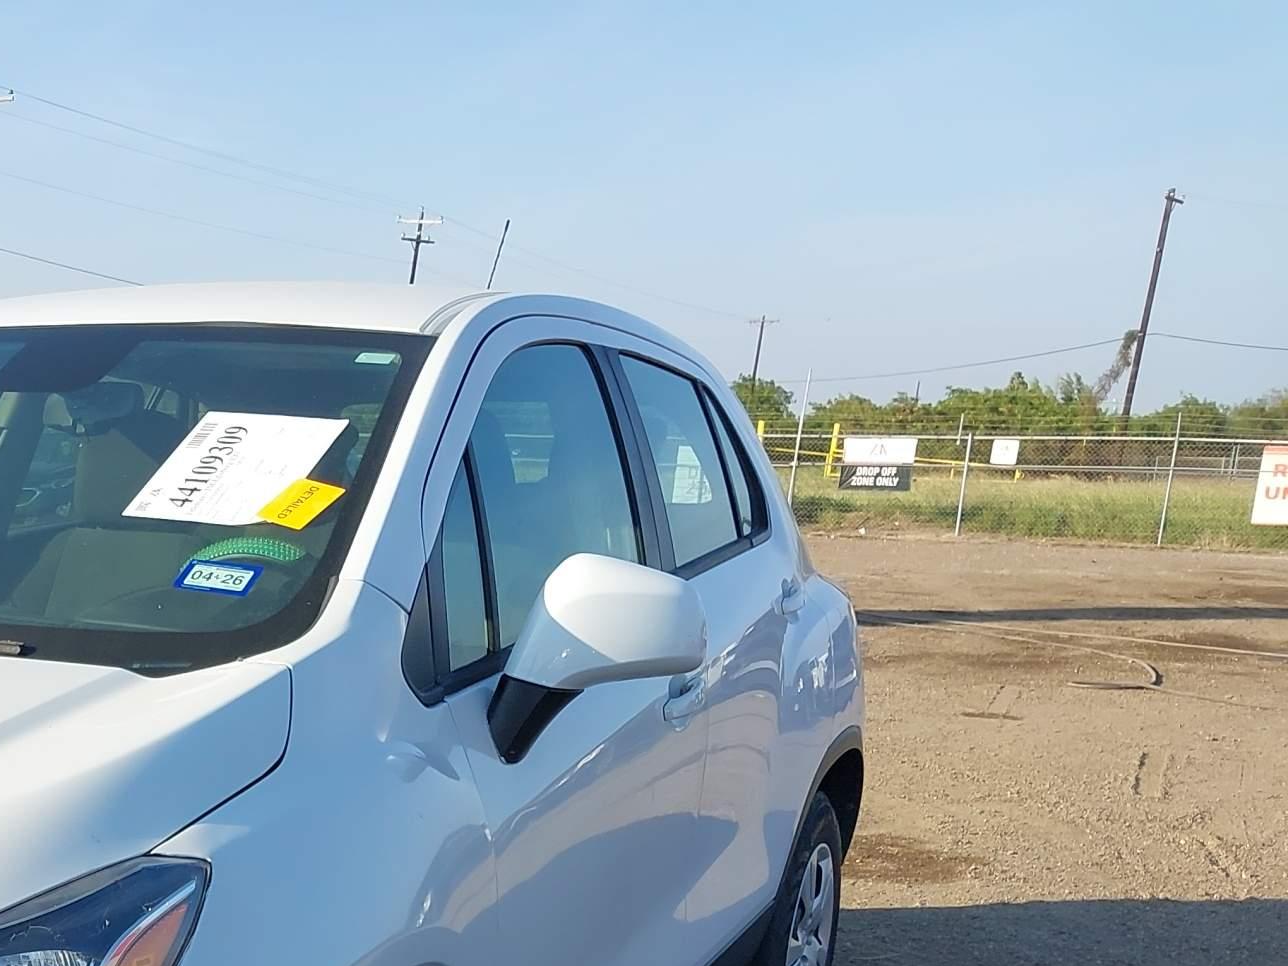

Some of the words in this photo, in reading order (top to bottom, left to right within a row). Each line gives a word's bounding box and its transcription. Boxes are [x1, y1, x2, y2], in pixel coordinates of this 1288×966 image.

[169, 426, 248, 508] 44109309
[856, 467, 880, 476] DROP
[881, 467, 897, 476] OFF
[850, 477, 874, 486] ZONE
[876, 477, 899, 486] ONLY
[278, 486, 319, 519] DETAILED
